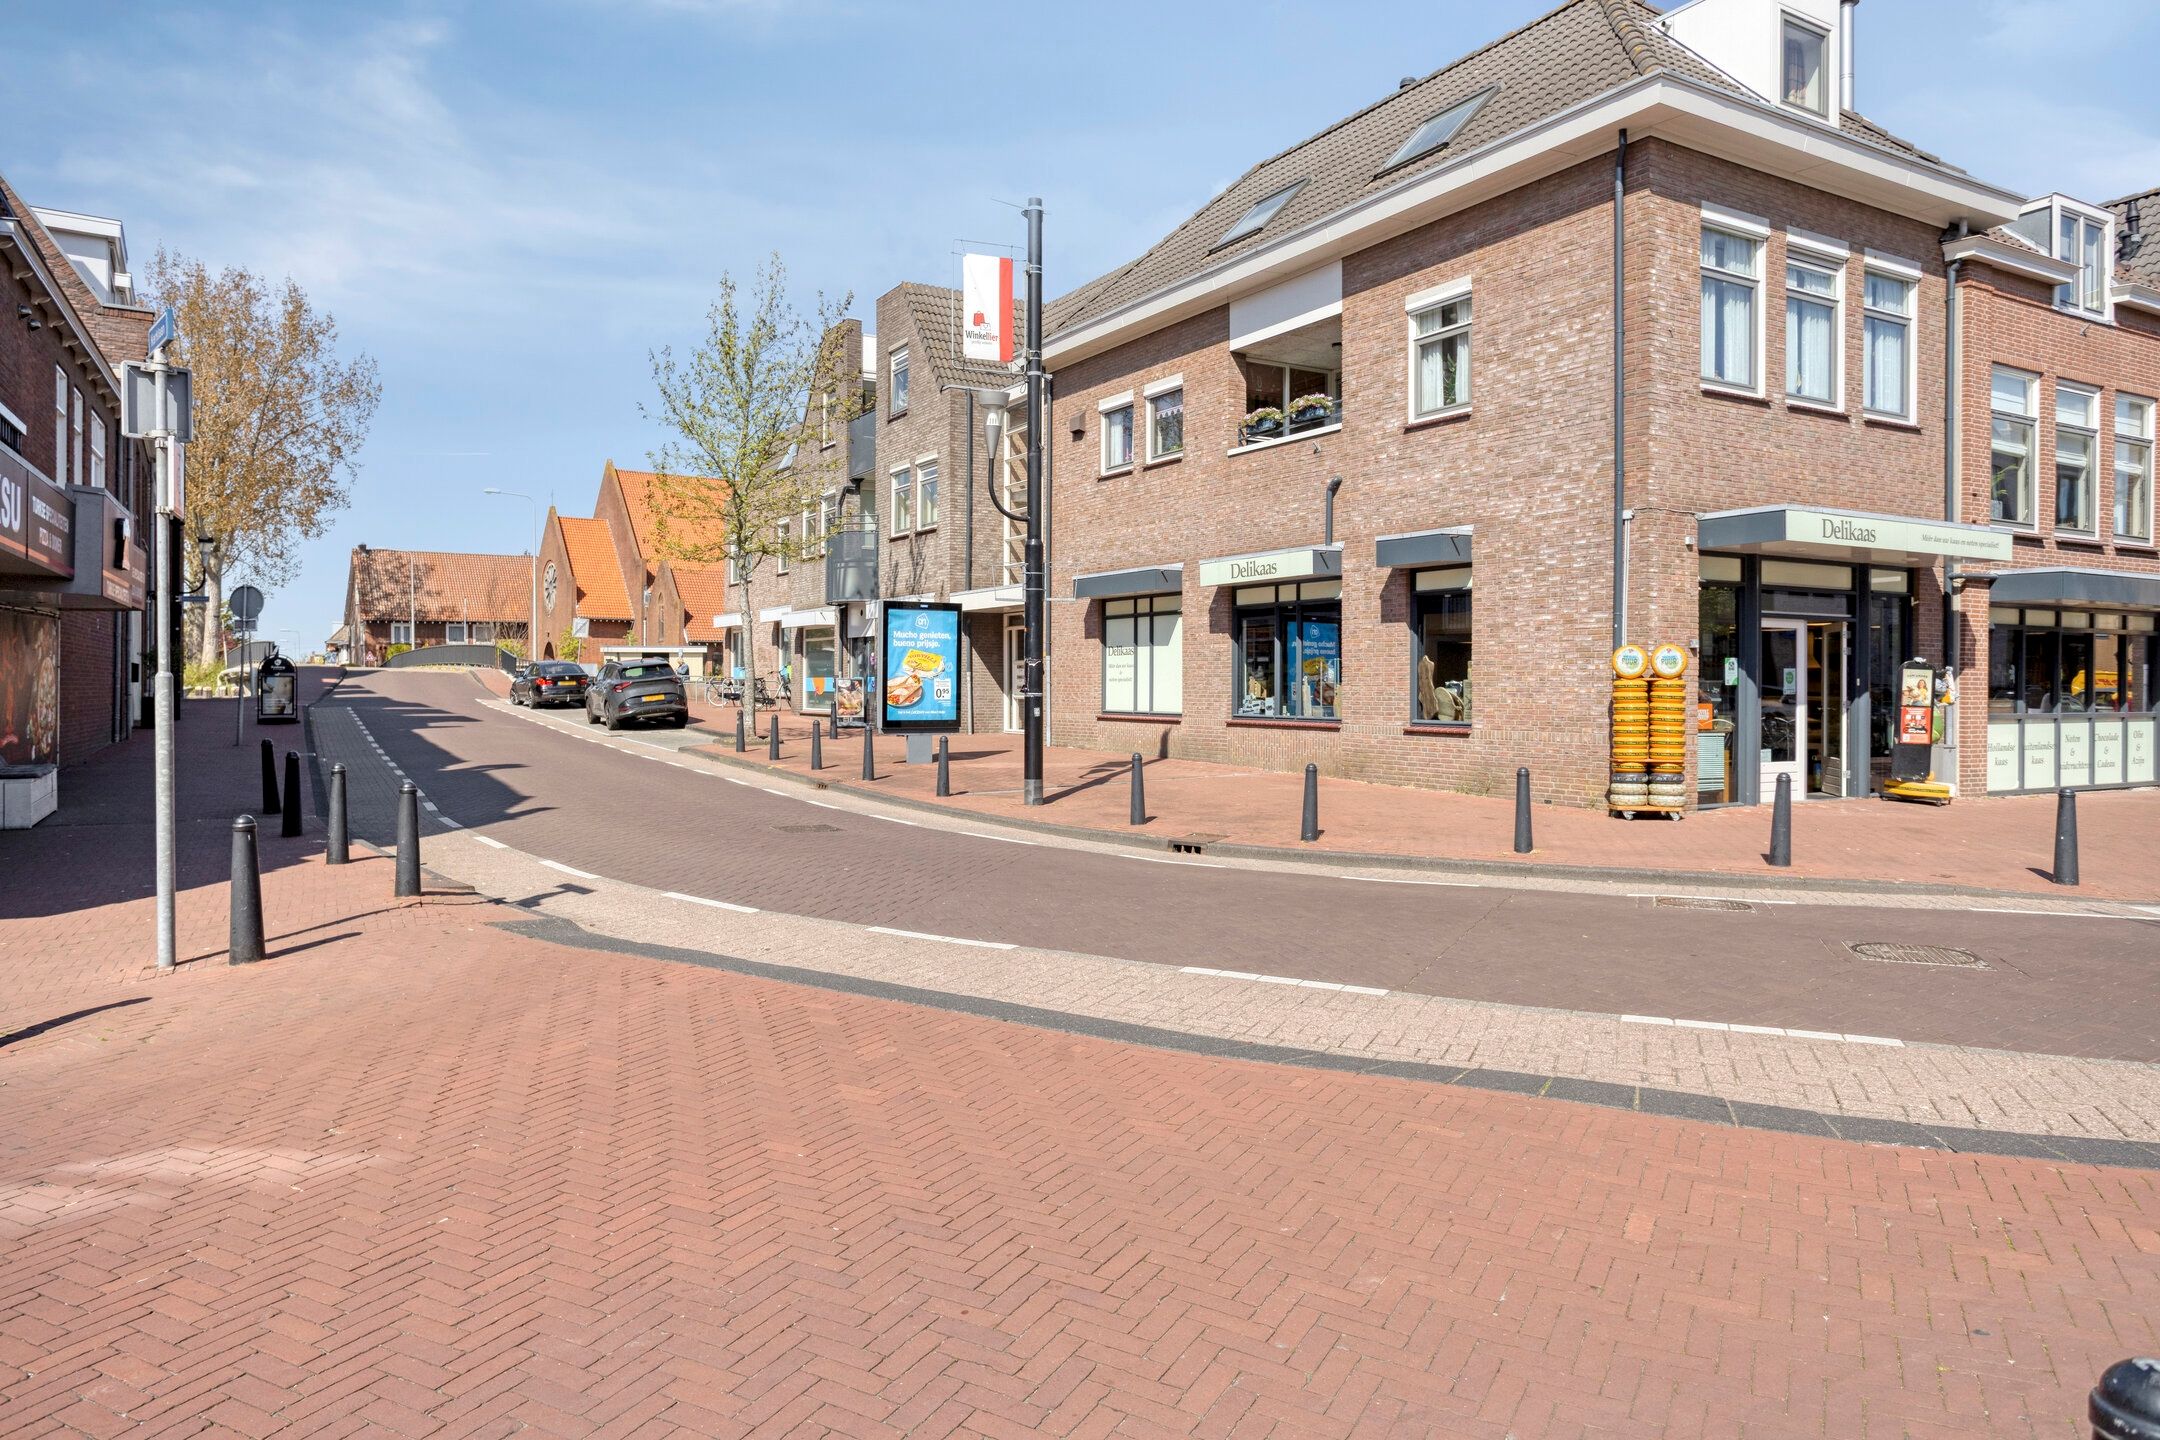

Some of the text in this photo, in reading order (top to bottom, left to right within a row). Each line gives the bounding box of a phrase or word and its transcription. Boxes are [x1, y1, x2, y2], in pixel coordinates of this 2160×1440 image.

[0, 473, 21, 533] SU
[1821, 518, 1876, 544] Delikaas
[1231, 560, 1277, 579] Delikaas
[893, 638, 915, 646] bueno
[1108, 646, 1135, 656] Delikaas
[2065, 734, 2081, 743] Noten
[2070, 748, 2076, 757] &
[2103, 746, 2109, 755] &
[1994, 757, 2008, 766] kaas
[2031, 755, 2044, 765] kaas
